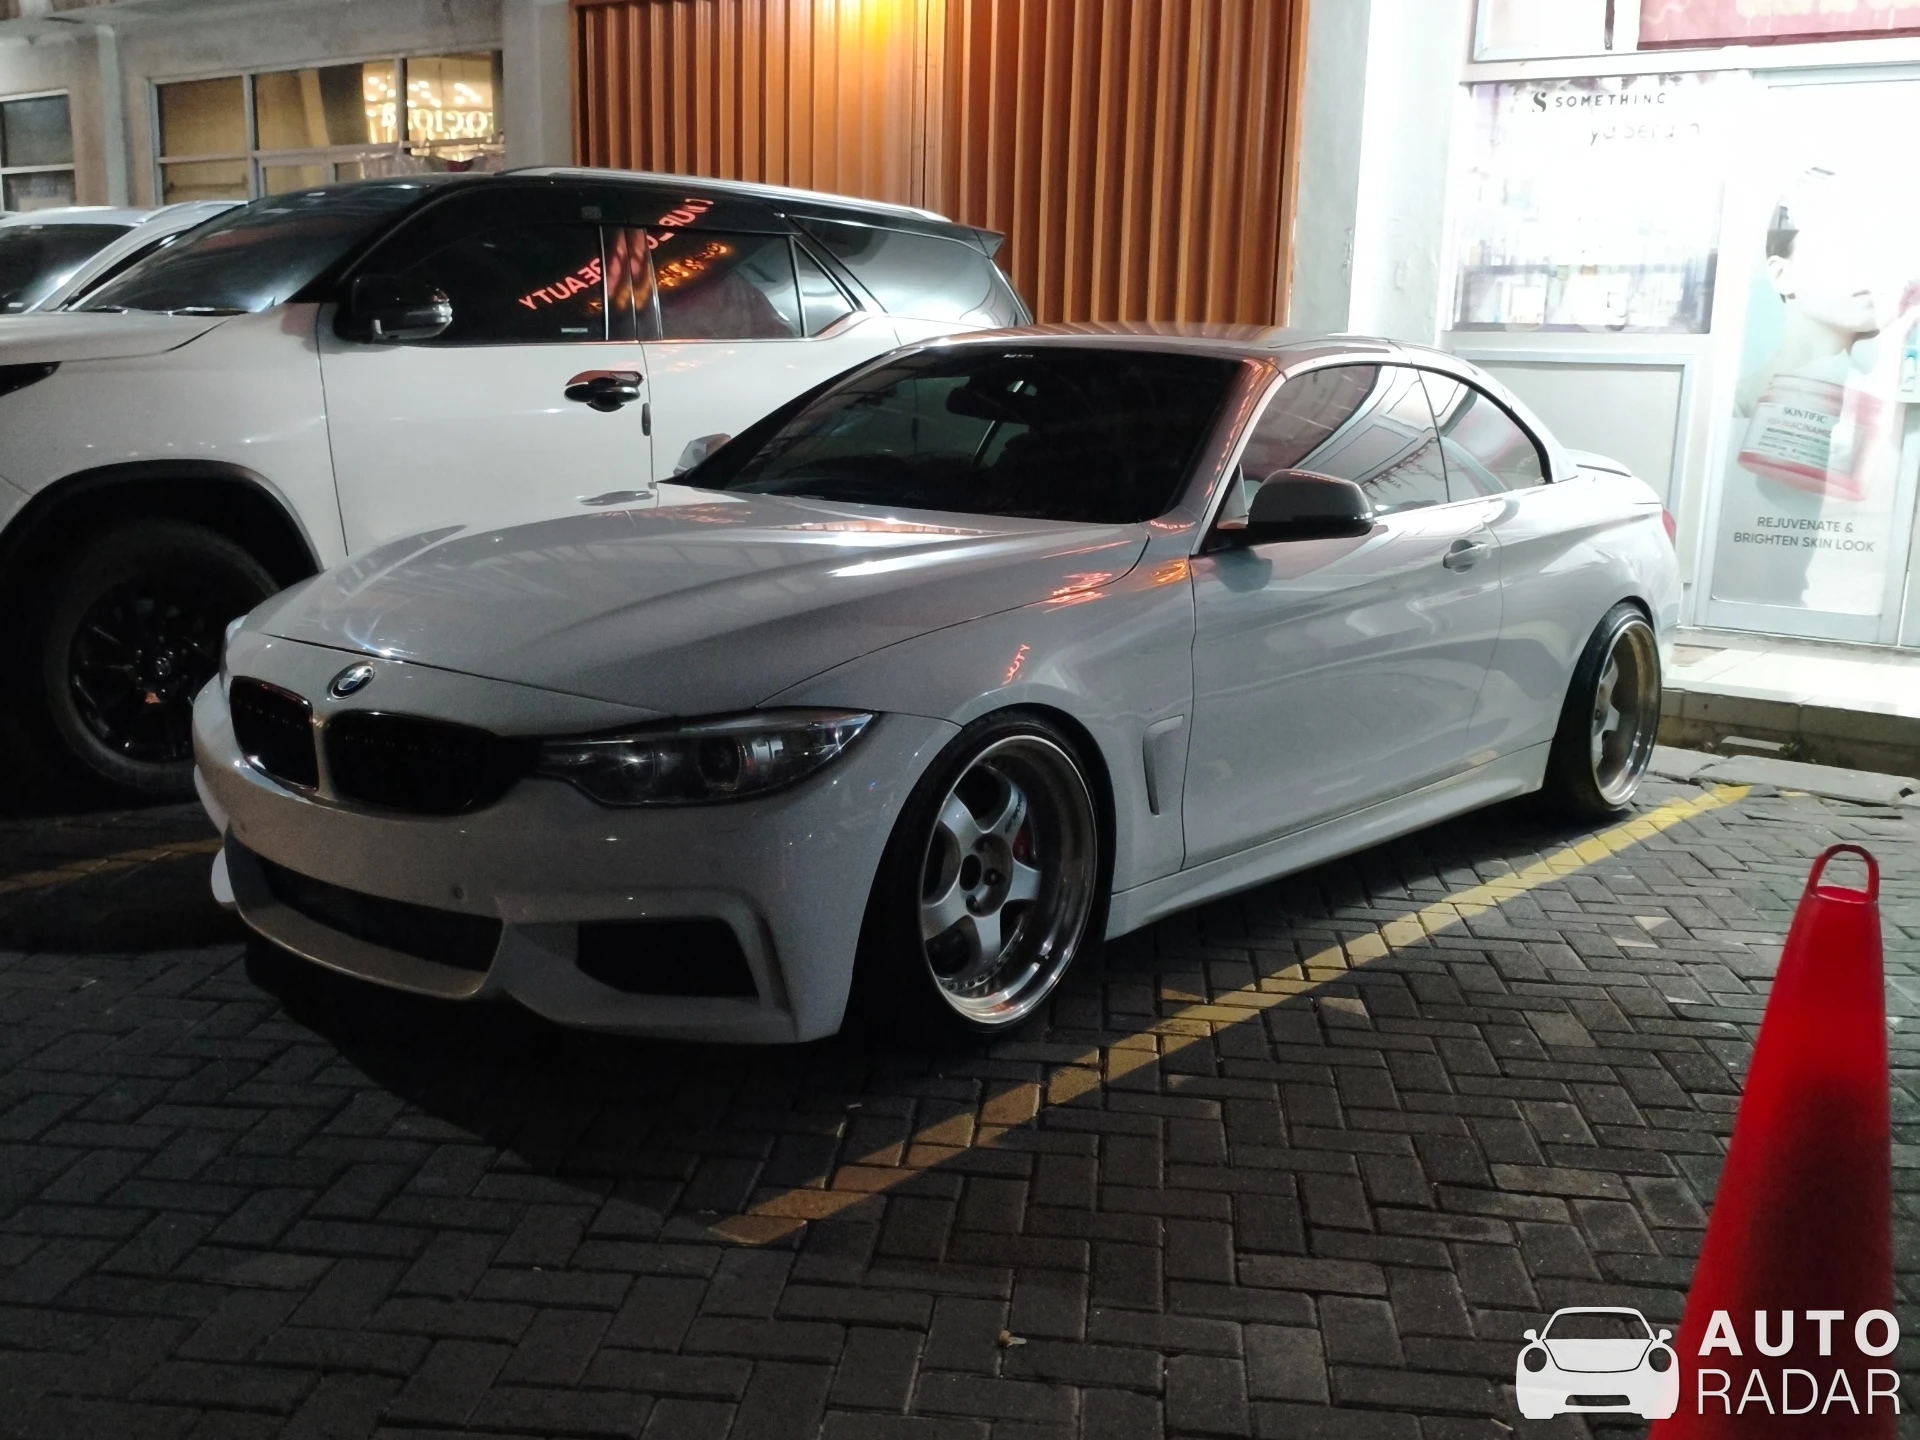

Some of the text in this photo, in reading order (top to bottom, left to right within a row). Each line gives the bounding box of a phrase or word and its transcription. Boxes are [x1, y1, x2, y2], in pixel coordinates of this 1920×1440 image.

[1556, 92, 1666, 108] SOMETHINC
[1757, 516, 1854, 533] REJUVENATE &
[1733, 531, 1875, 553] BRIGHTEN SKIN LOOK
